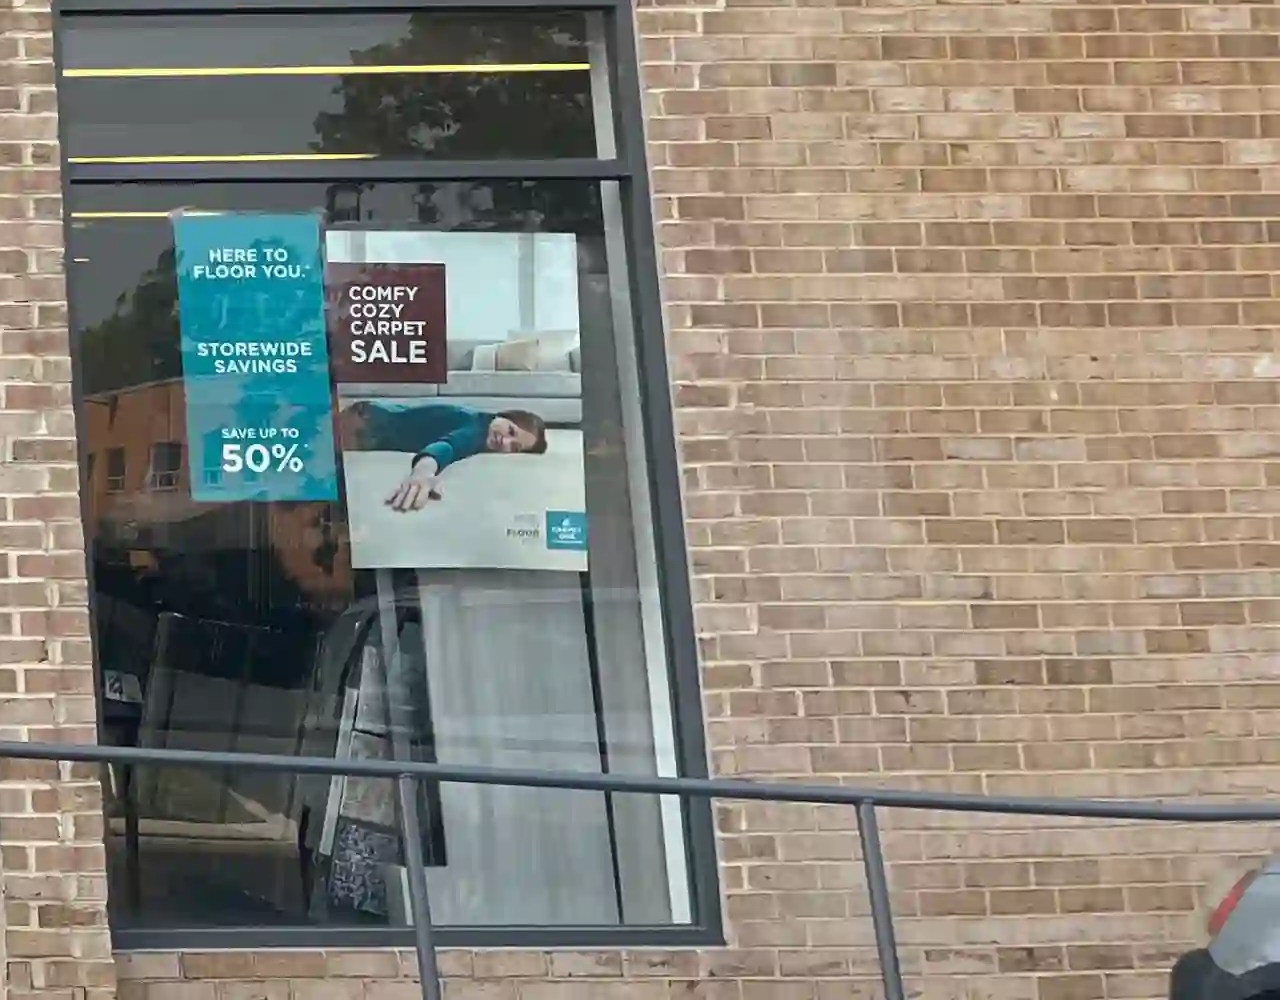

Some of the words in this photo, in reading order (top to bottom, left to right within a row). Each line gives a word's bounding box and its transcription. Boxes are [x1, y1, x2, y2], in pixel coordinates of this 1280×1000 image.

[209, 248, 258, 263] HERE
[263, 249, 288, 263] TO
[193, 264, 257, 279] FLOOR
[348, 285, 419, 302] COMFY
[349, 303, 405, 319] COZY
[350, 320, 427, 336] CARPET
[197, 342, 313, 357] STOREWIDE
[350, 339, 428, 364] SALE
[214, 359, 298, 374] SAVINGS
[221, 427, 256, 439] SAVE
[260, 427, 278, 438] UP
[281, 427, 300, 438] TO
